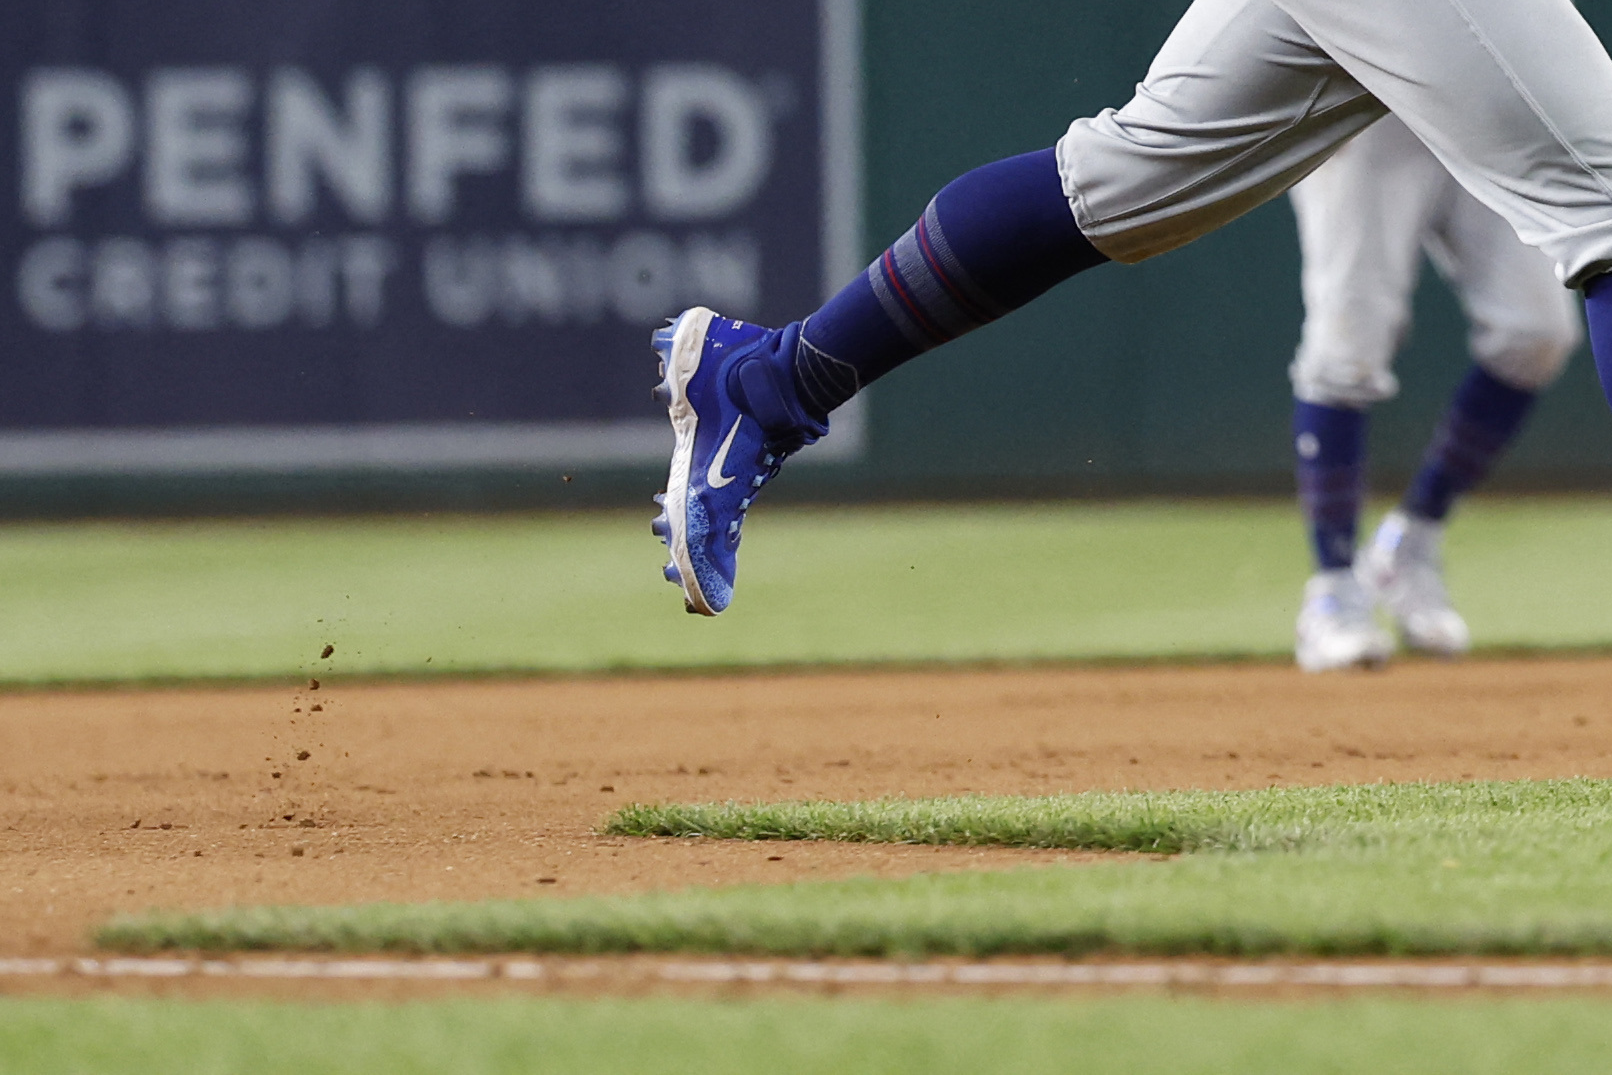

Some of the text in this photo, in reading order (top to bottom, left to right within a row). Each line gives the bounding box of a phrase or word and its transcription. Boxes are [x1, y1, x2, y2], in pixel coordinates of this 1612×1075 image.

[21, 66, 775, 225] PENFED
[18, 234, 760, 330] CREDIT UNION
